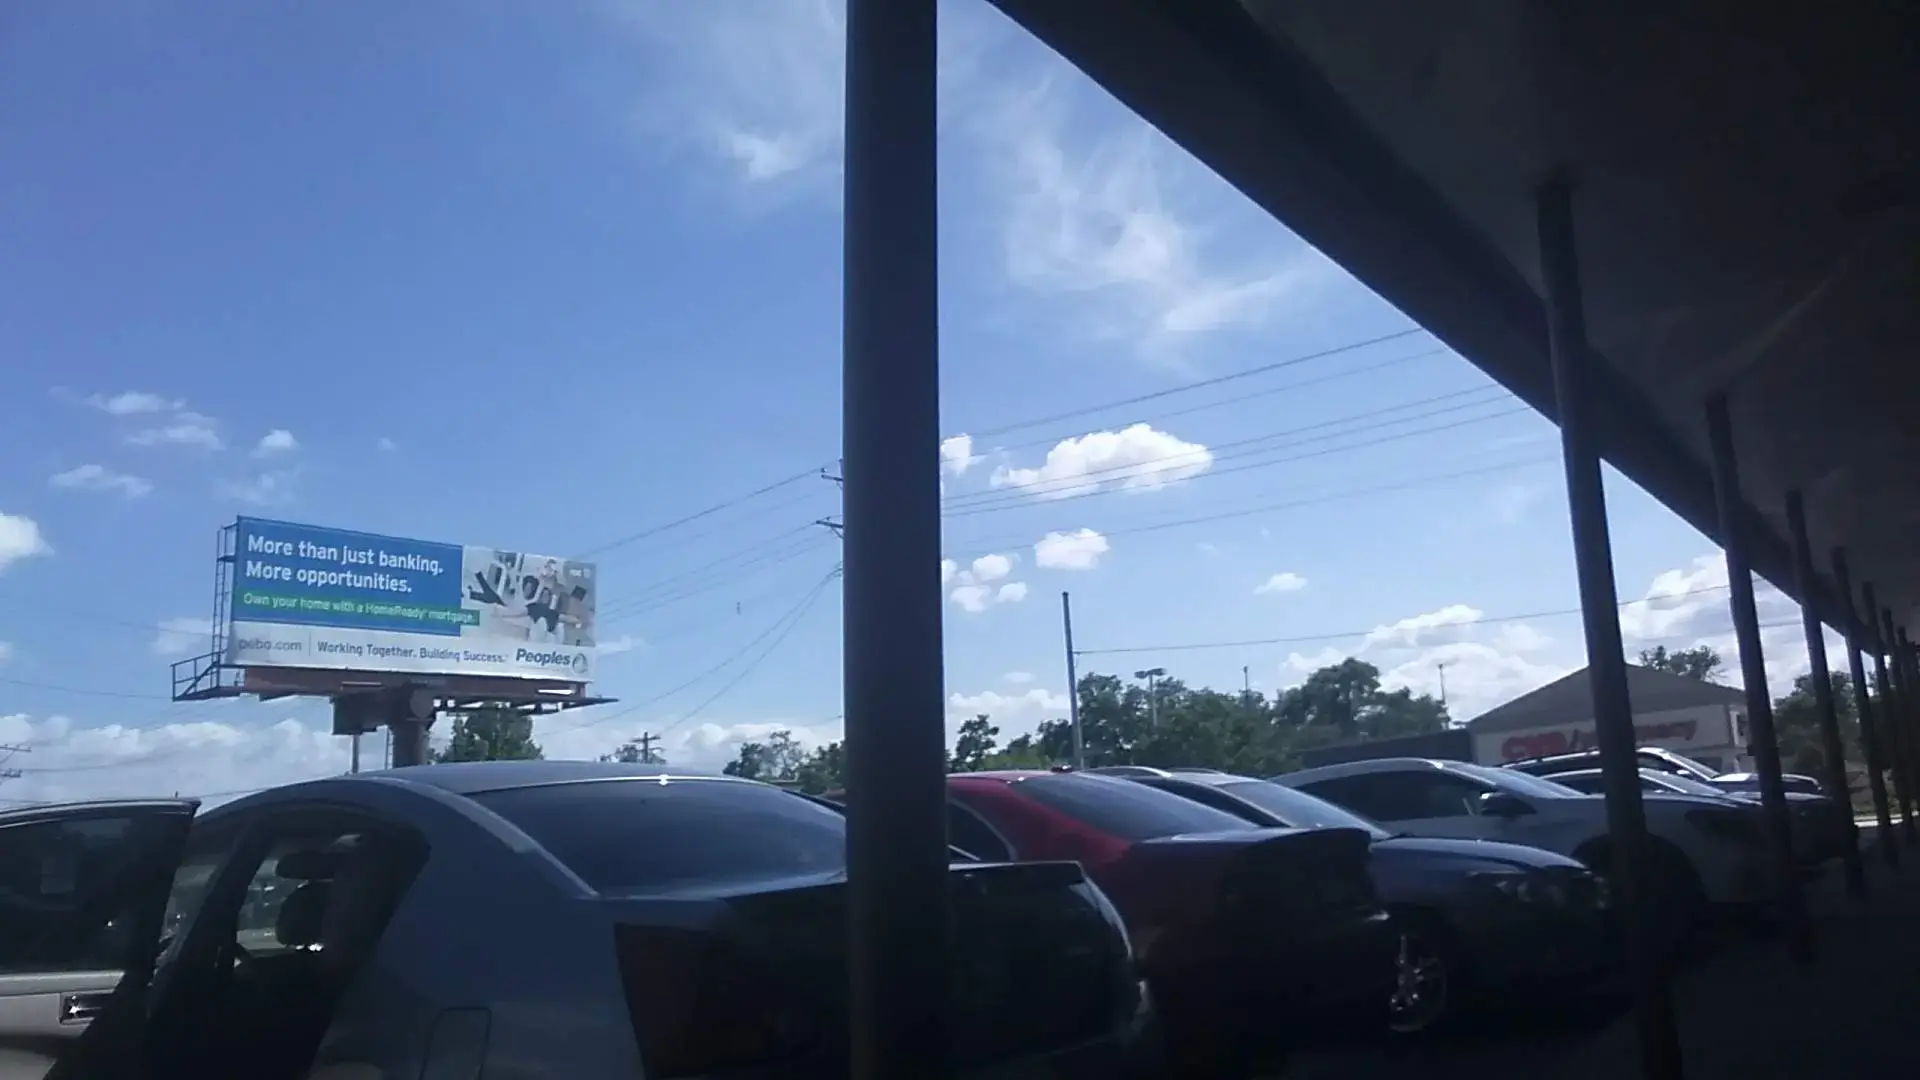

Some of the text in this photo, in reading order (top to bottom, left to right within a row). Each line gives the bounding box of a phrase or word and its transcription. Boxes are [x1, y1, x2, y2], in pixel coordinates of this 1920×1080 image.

[247, 534, 444, 576] More than just banking.
[246, 560, 412, 593] More opportunities.
[243, 593, 270, 605] Own
[272, 596, 298, 609] your
[300, 597, 330, 610] home
[332, 601, 355, 612] with
[356, 605, 364, 613] a
[317, 640, 363, 656] Working
[366, 644, 417, 659] Together.
[419, 647, 461, 663] Building
[515, 647, 571, 666] Peoples
